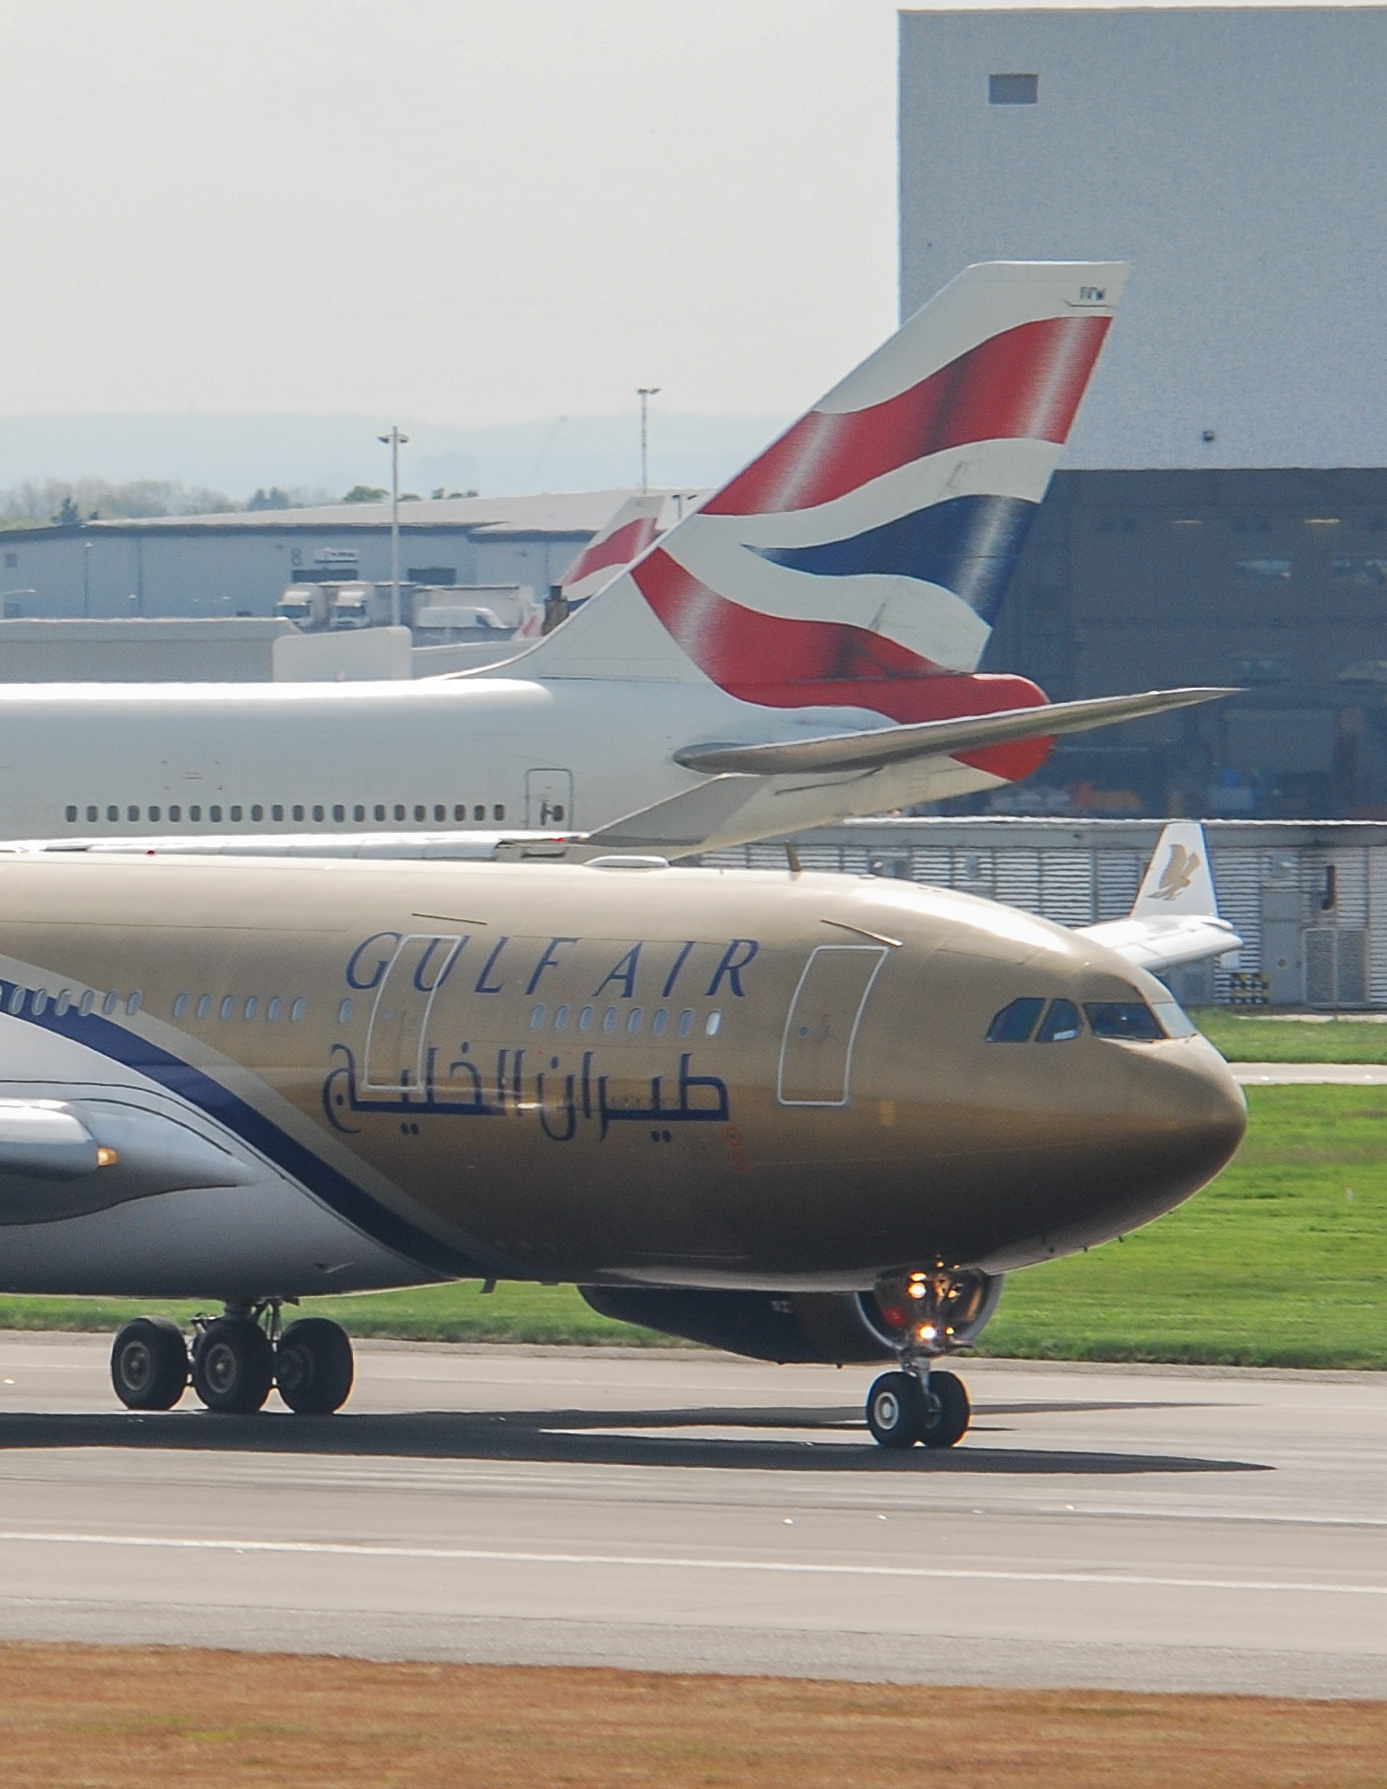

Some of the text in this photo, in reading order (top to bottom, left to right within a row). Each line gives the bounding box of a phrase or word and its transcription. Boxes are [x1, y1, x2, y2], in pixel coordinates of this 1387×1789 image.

[345, 931, 759, 999] GULF AIR
[322, 1041, 730, 1142] طيران الخليج
